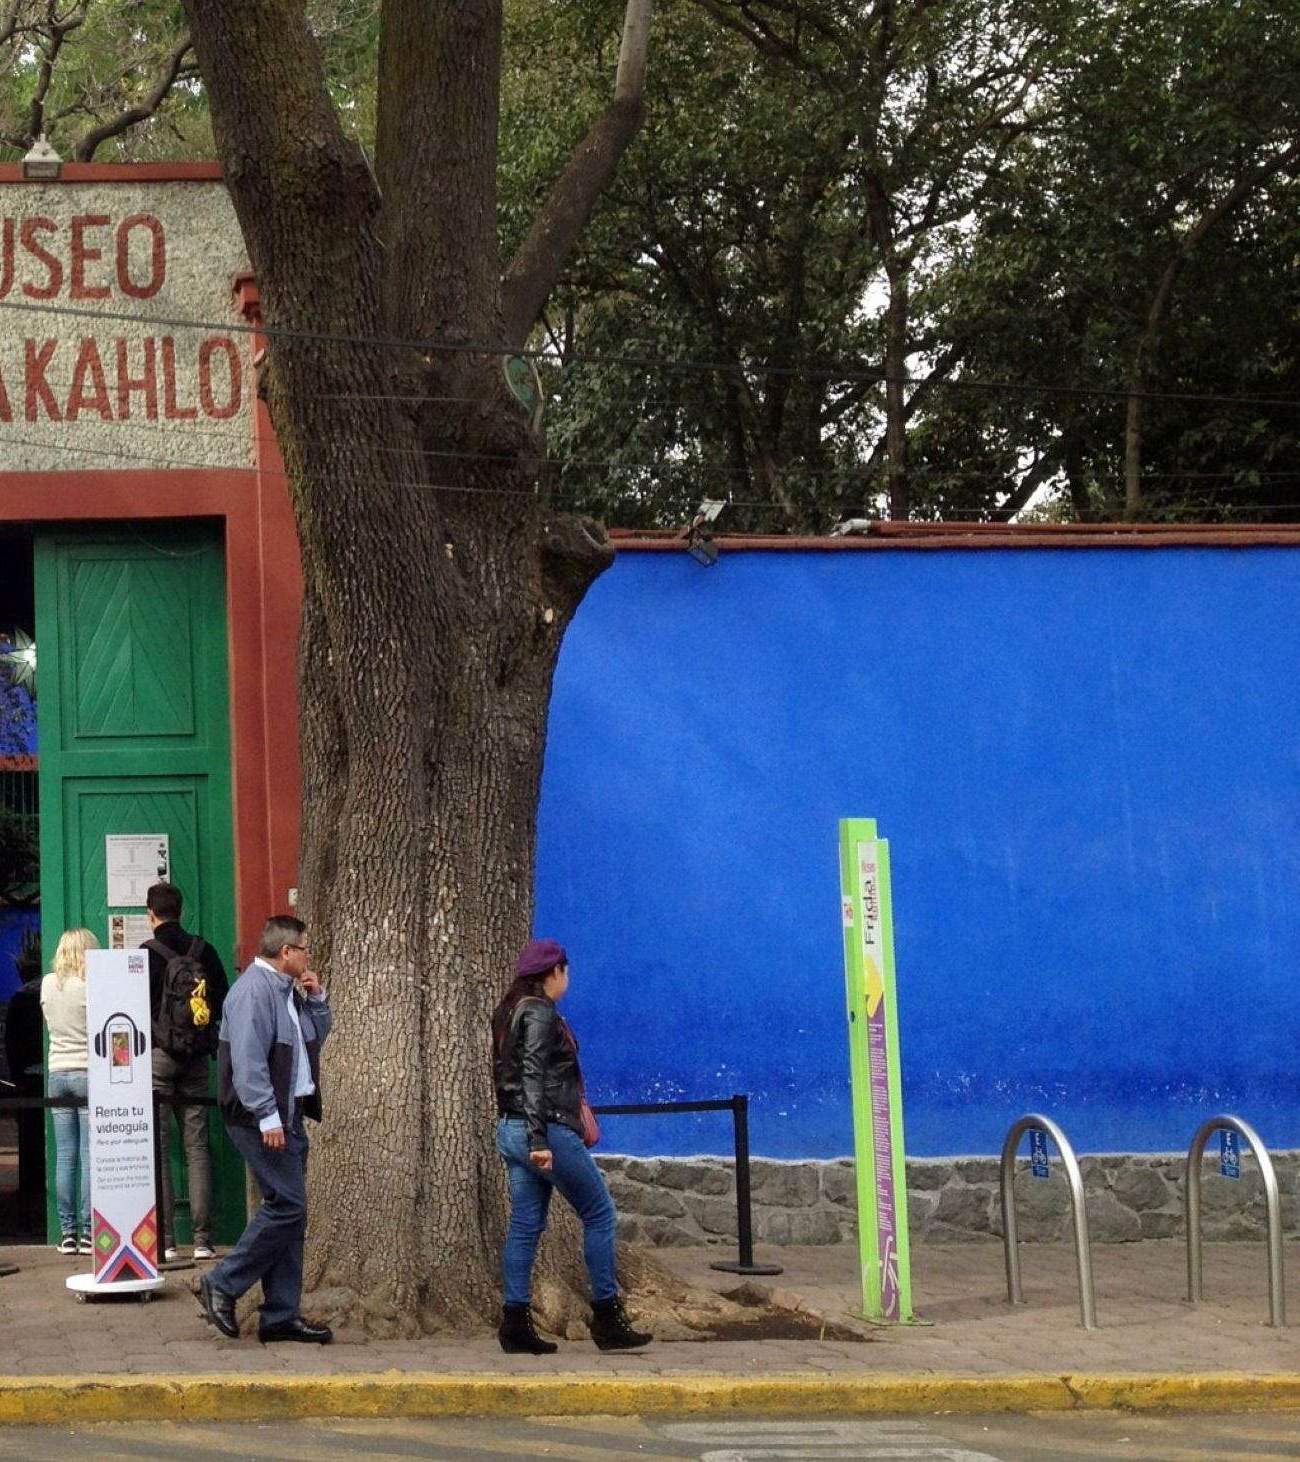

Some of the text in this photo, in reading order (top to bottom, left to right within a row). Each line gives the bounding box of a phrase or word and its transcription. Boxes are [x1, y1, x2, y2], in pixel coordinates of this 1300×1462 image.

[24, 336, 243, 422] KAHLO
[863, 880, 875, 945] Frida
[95, 1106, 144, 1118] Renta tu
[96, 1120, 149, 1135] videoguía
